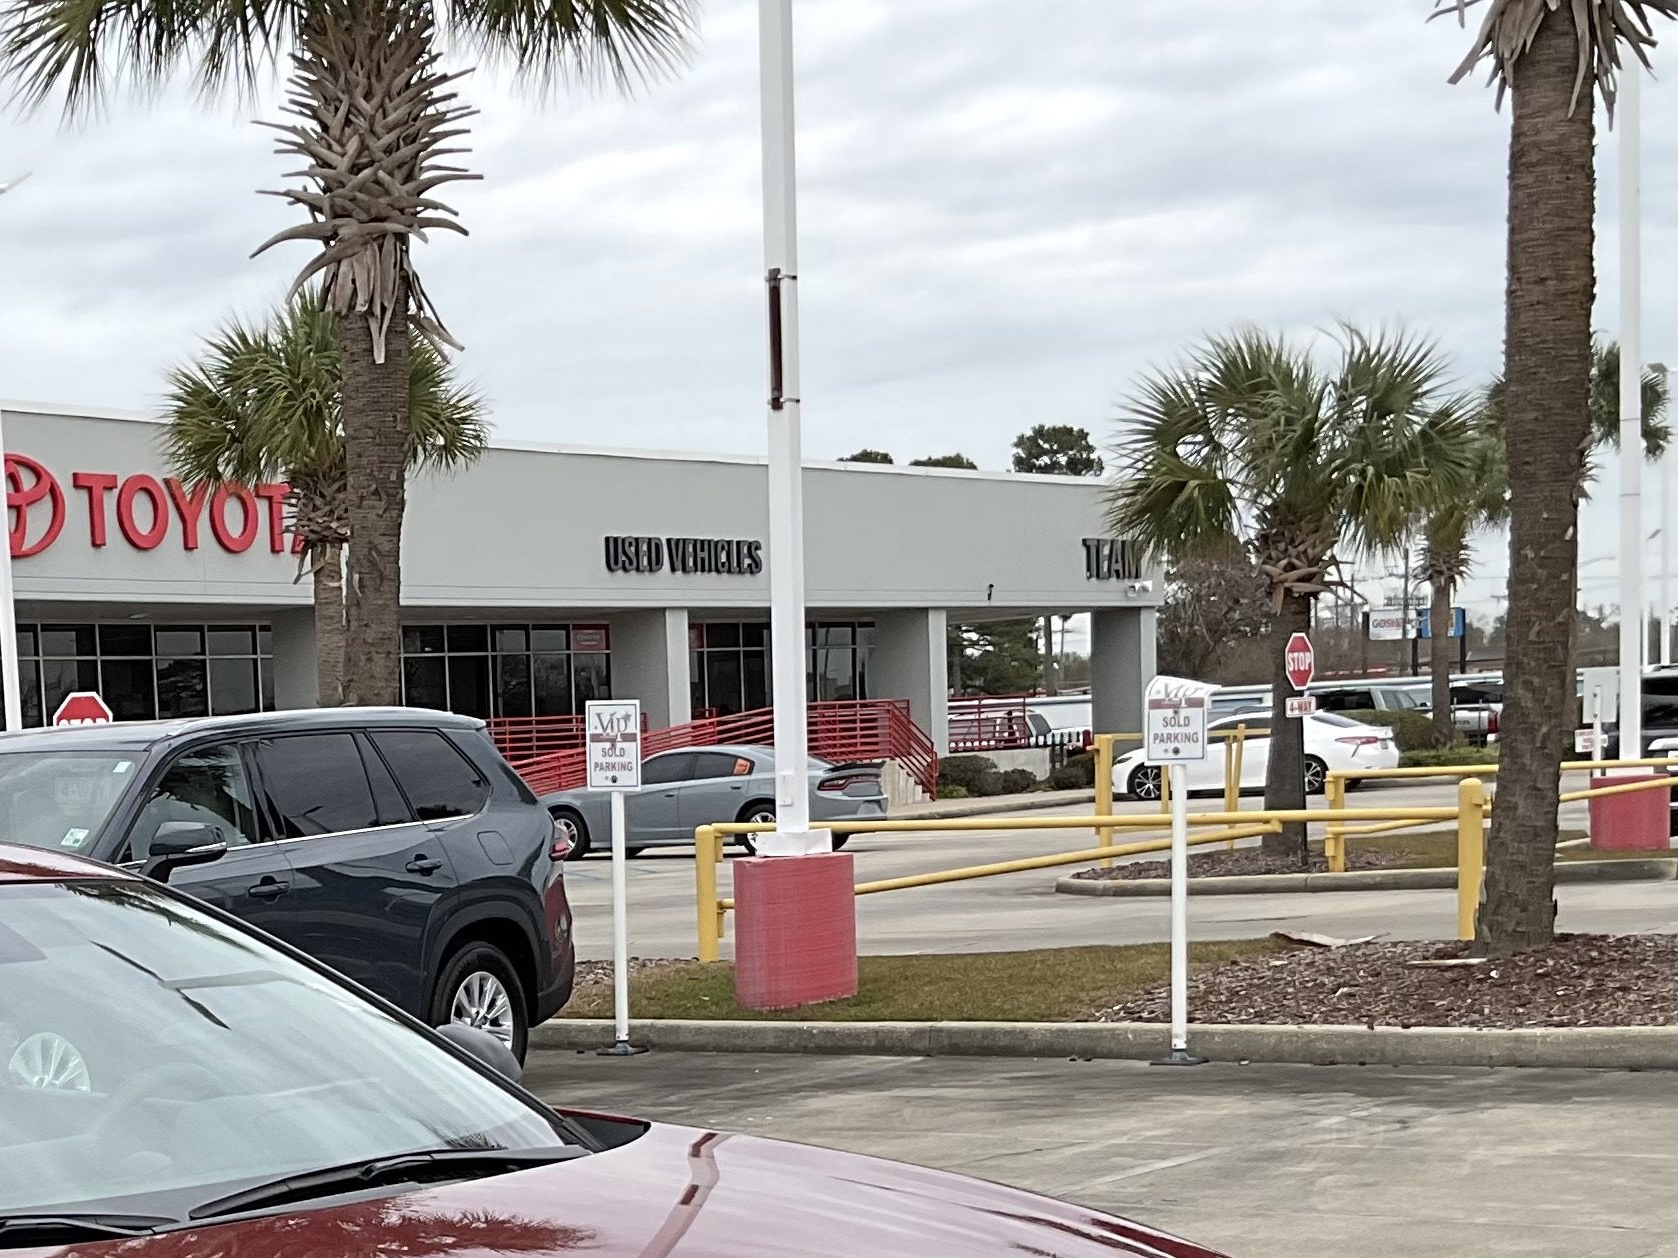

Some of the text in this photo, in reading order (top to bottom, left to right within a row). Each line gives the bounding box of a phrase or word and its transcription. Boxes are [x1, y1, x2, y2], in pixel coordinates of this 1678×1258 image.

[73, 472, 304, 554] TOYOT
[604, 536, 763, 574] USED VEHICLES
[1082, 538, 1142, 579] TEAM
[1288, 652, 1311, 671] STOP
[1289, 701, 1312, 713] 4-WAY
[1162, 716, 1191, 728] SOLD
[1153, 732, 1200, 744] PARKING
[601, 747, 626, 758] SOLD
[593, 762, 634, 773] PARKING
